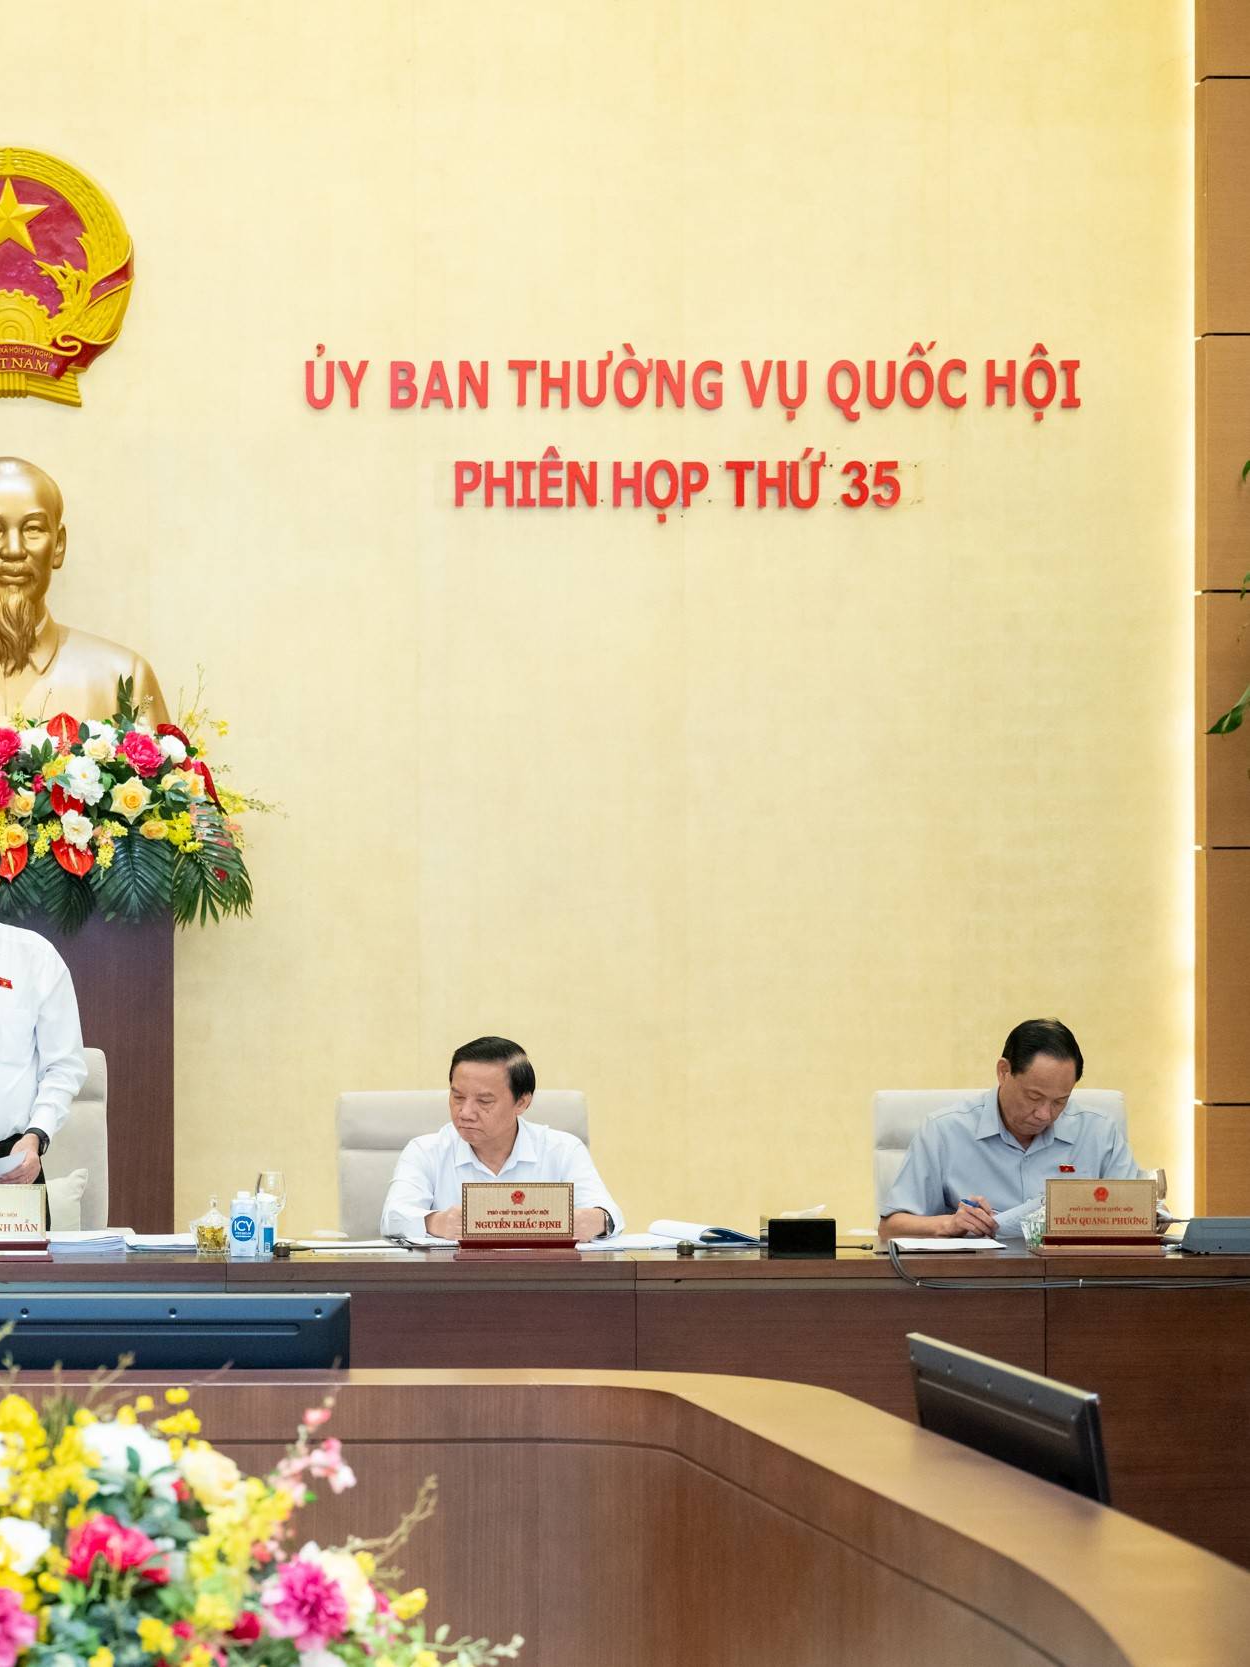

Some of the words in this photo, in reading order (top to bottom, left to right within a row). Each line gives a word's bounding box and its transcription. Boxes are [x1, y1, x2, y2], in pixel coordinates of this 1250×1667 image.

[11, 357, 49, 372] NAM
[305, 344, 369, 409] ỦY
[389, 360, 489, 408] BAN
[507, 343, 723, 409] THƯỜNG
[741, 360, 807, 420] VỤ
[827, 342, 967, 422] QUỐC
[985, 343, 1081, 421] HỘI
[454, 446, 598, 508] PHIÊN
[612, 459, 710, 523] HỌP
[724, 448, 827, 510] THỨ
[841, 460, 902, 509] 35
[14, 1218, 39, 1232] MẪN
[234, 1220, 253, 1232] ICY
[475, 1217, 511, 1229] NGUYỄN
[513, 1218, 537, 1229] KHẮC
[539, 1220, 562, 1230] ĐỊNH
[1054, 1213, 1078, 1225] TRẦN
[1079, 1216, 1110, 1226] QUANG
[1112, 1215, 1148, 1225] PHƯƠNG
